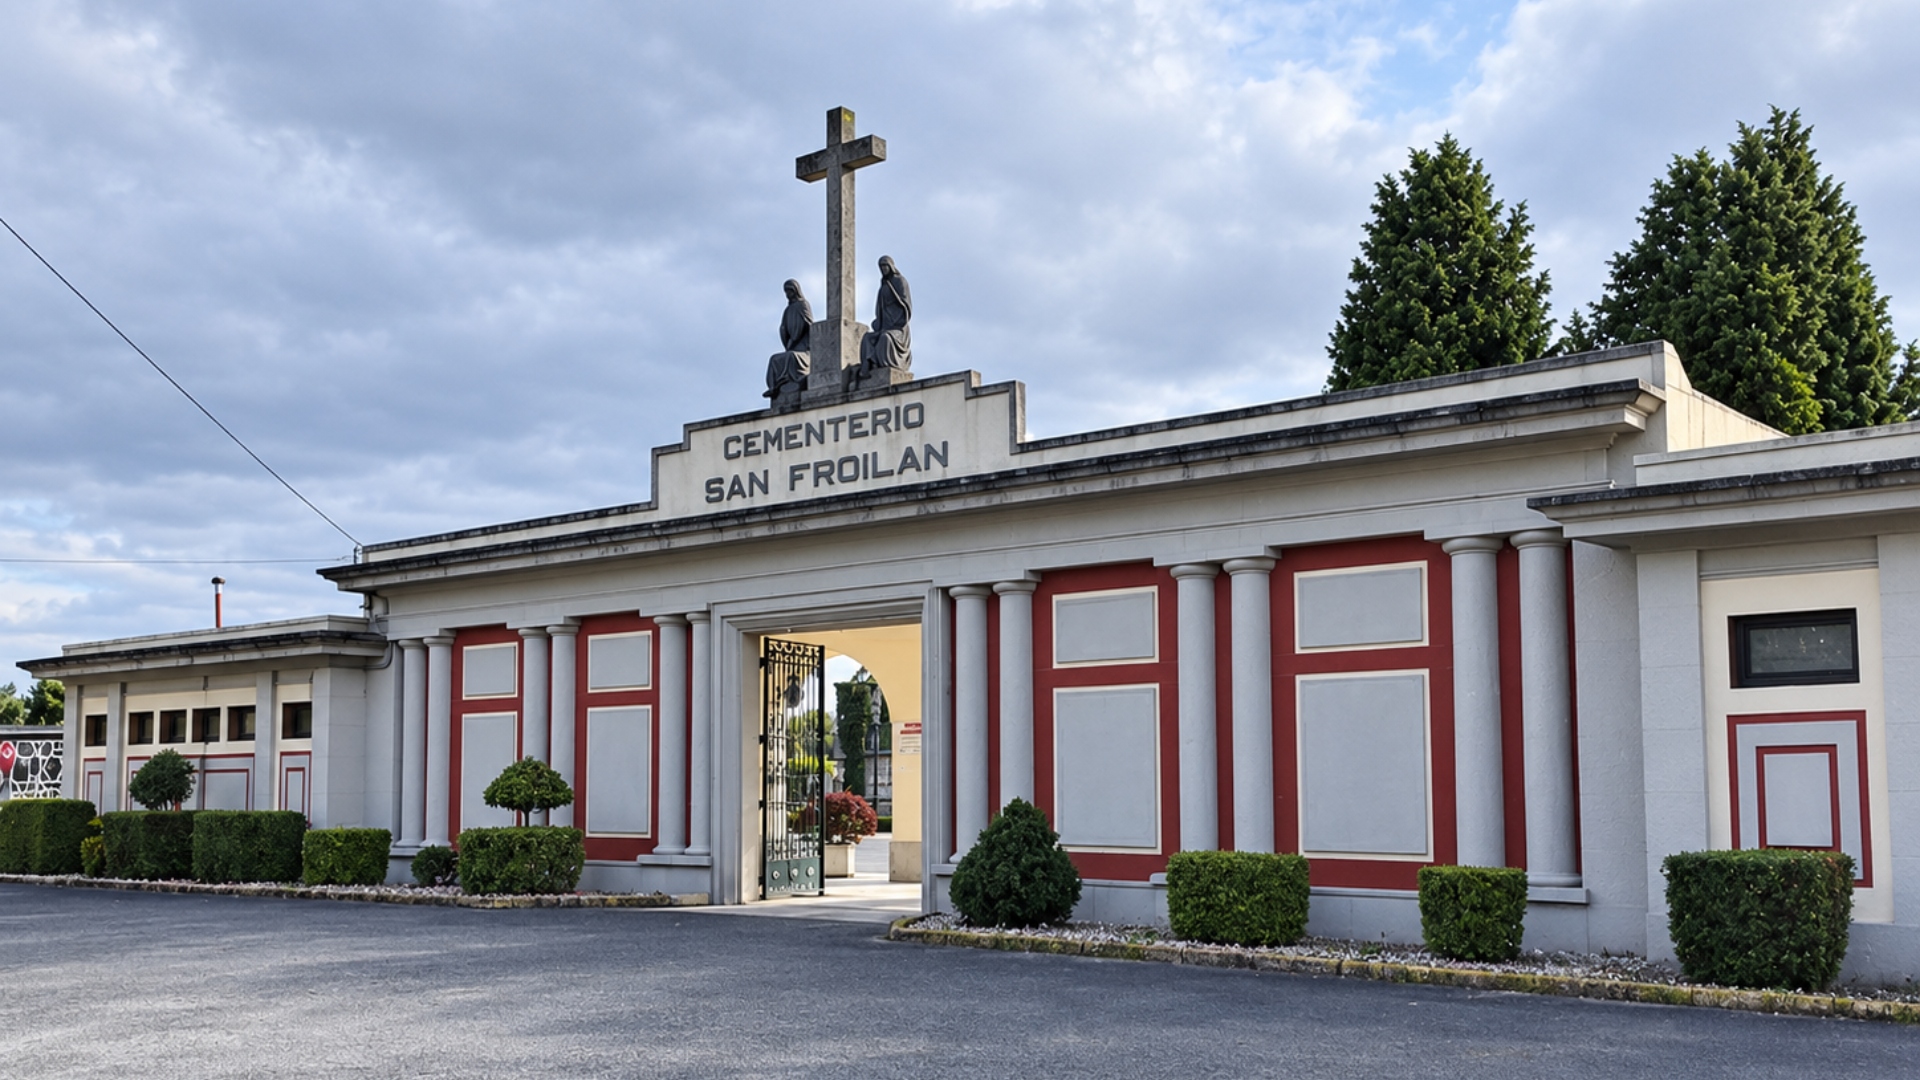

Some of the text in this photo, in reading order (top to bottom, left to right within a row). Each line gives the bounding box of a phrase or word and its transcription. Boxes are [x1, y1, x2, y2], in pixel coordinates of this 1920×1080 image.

[723, 402, 925, 461] CEMENTERIO
[705, 441, 949, 503] SAN FROILAN
